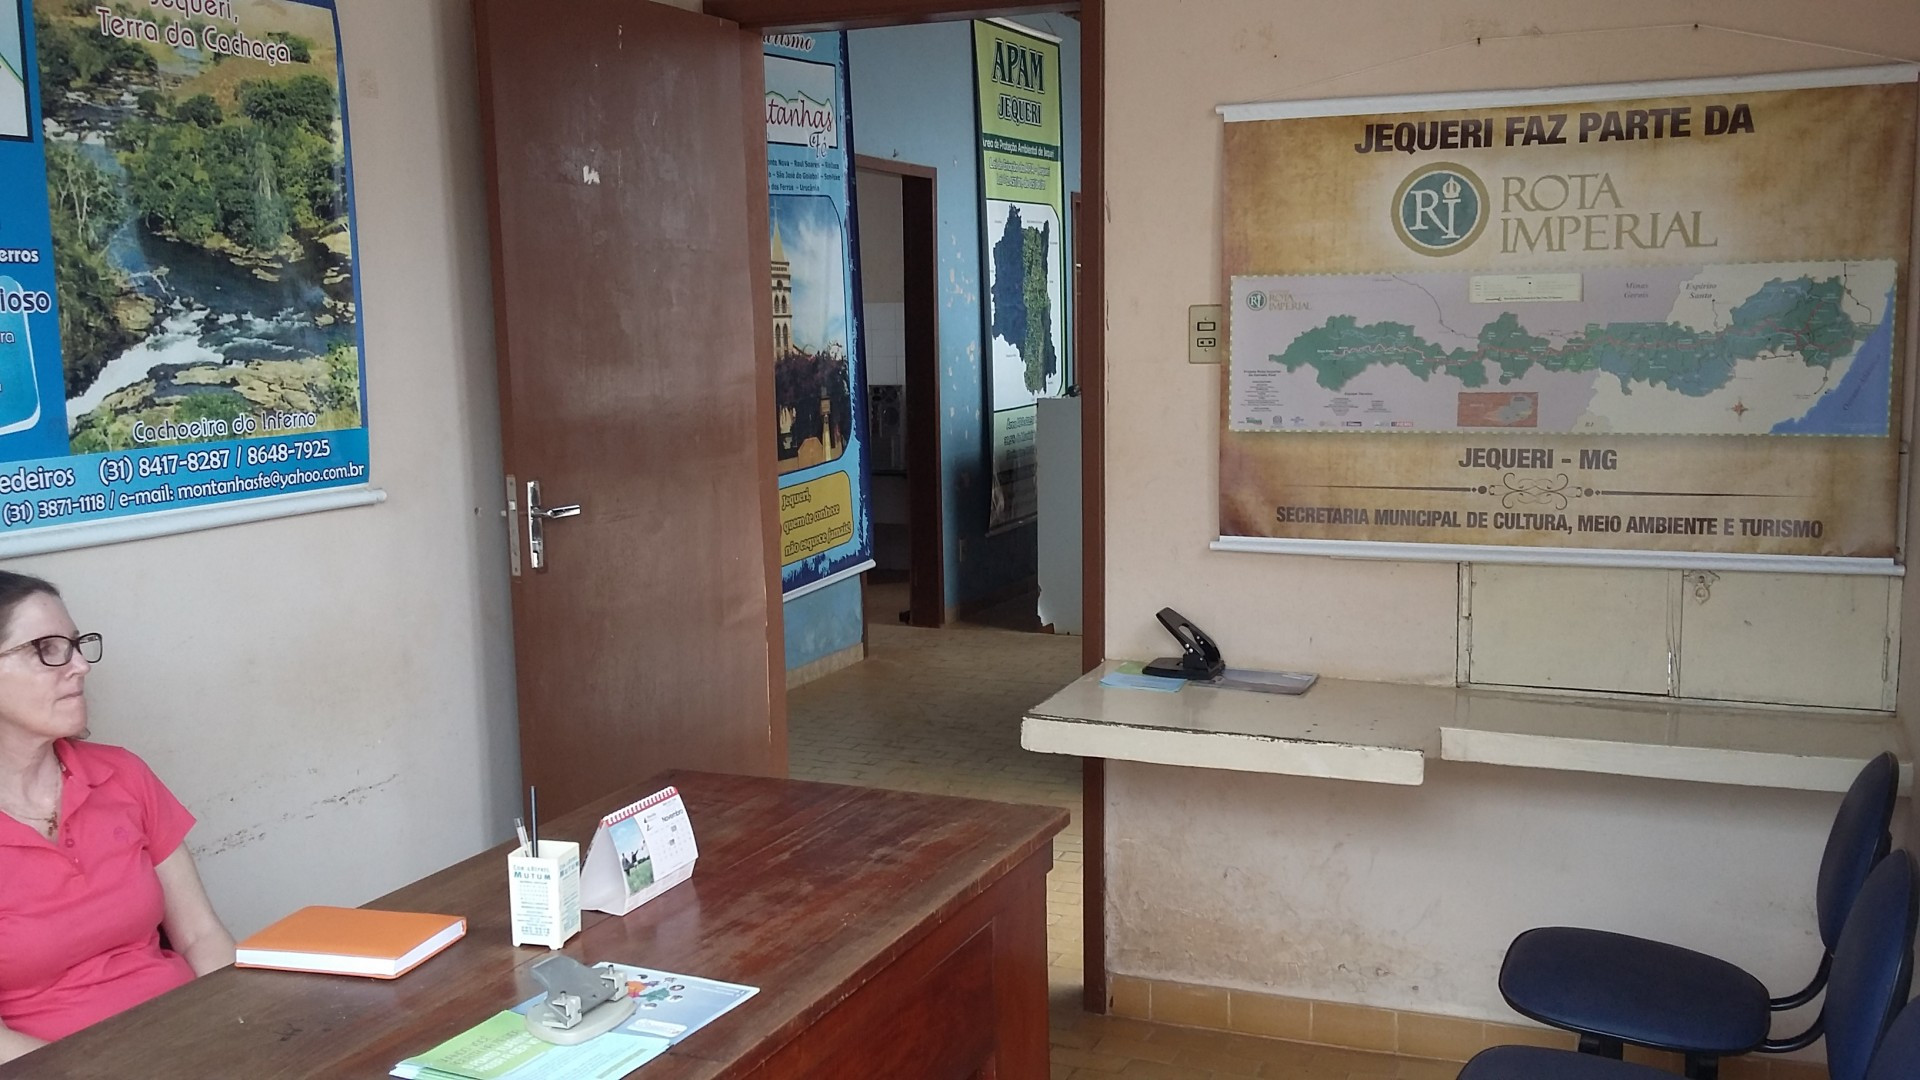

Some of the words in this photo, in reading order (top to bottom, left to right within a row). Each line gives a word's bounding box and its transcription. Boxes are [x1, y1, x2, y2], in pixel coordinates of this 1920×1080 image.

[97, 7, 159, 42] Terra
[166, 22, 196, 47] da
[203, 26, 290, 65] Cachaça
[992, 39, 1045, 93] APAM
[998, 94, 1042, 126] JEQUERI
[1354, 118, 1494, 154] JEQUERI
[1505, 114, 1567, 147] FAZ
[1578, 107, 1692, 143] PARTE
[1704, 104, 1755, 135] DA
[1501, 172, 1624, 212] ROTA
[1500, 211, 1718, 253] IMPERIAL
[134, 415, 227, 442] Cachoeira
[232, 413, 256, 433] do
[262, 411, 316, 431] Inferno
[100, 456, 134, 486] (31)
[139, 449, 230, 480] 8417-8287
[235, 445, 242, 468] /
[247, 440, 331, 466] 8648-7925
[1458, 448, 1554, 471] JEQUERI
[1579, 449, 1618, 470] MG
[3, 501, 34, 526] (31)
[38, 494, 105, 519] 3871-1118
[108, 490, 115, 510] /
[119, 484, 174, 507] e-mail:
[177, 462, 365, 500] montanhasfe@yahoo.com.br
[1276, 506, 1369, 525] SECRETARIA
[1374, 509, 1461, 528] MUNICIPAL
[1467, 512, 1488, 529] DE
[1493, 512, 1572, 535] CULTURA,
[1577, 515, 1622, 532] MEIO
[1626, 516, 1718, 535] AMBIENTE
[1723, 518, 1735, 535] E
[1739, 519, 1824, 538] TURISMO
[785, 541, 799, 557] não
